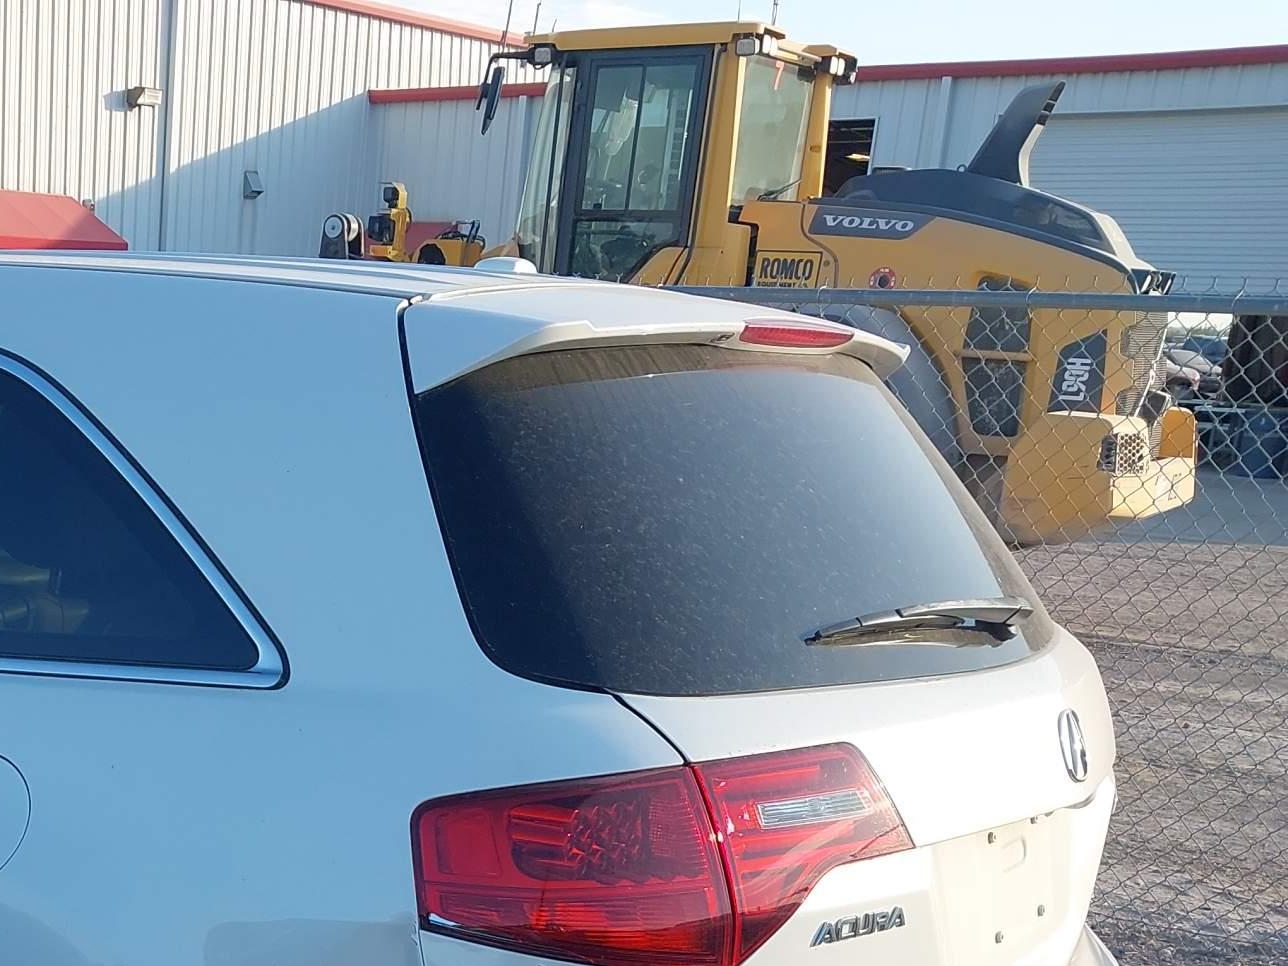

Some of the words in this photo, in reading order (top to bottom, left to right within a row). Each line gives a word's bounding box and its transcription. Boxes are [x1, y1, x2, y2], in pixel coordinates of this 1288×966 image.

[823, 214, 914, 232] VOLVO
[759, 257, 814, 281] ROMCO
[1059, 357, 1092, 401] L90H
[809, 906, 906, 948] ACURA
